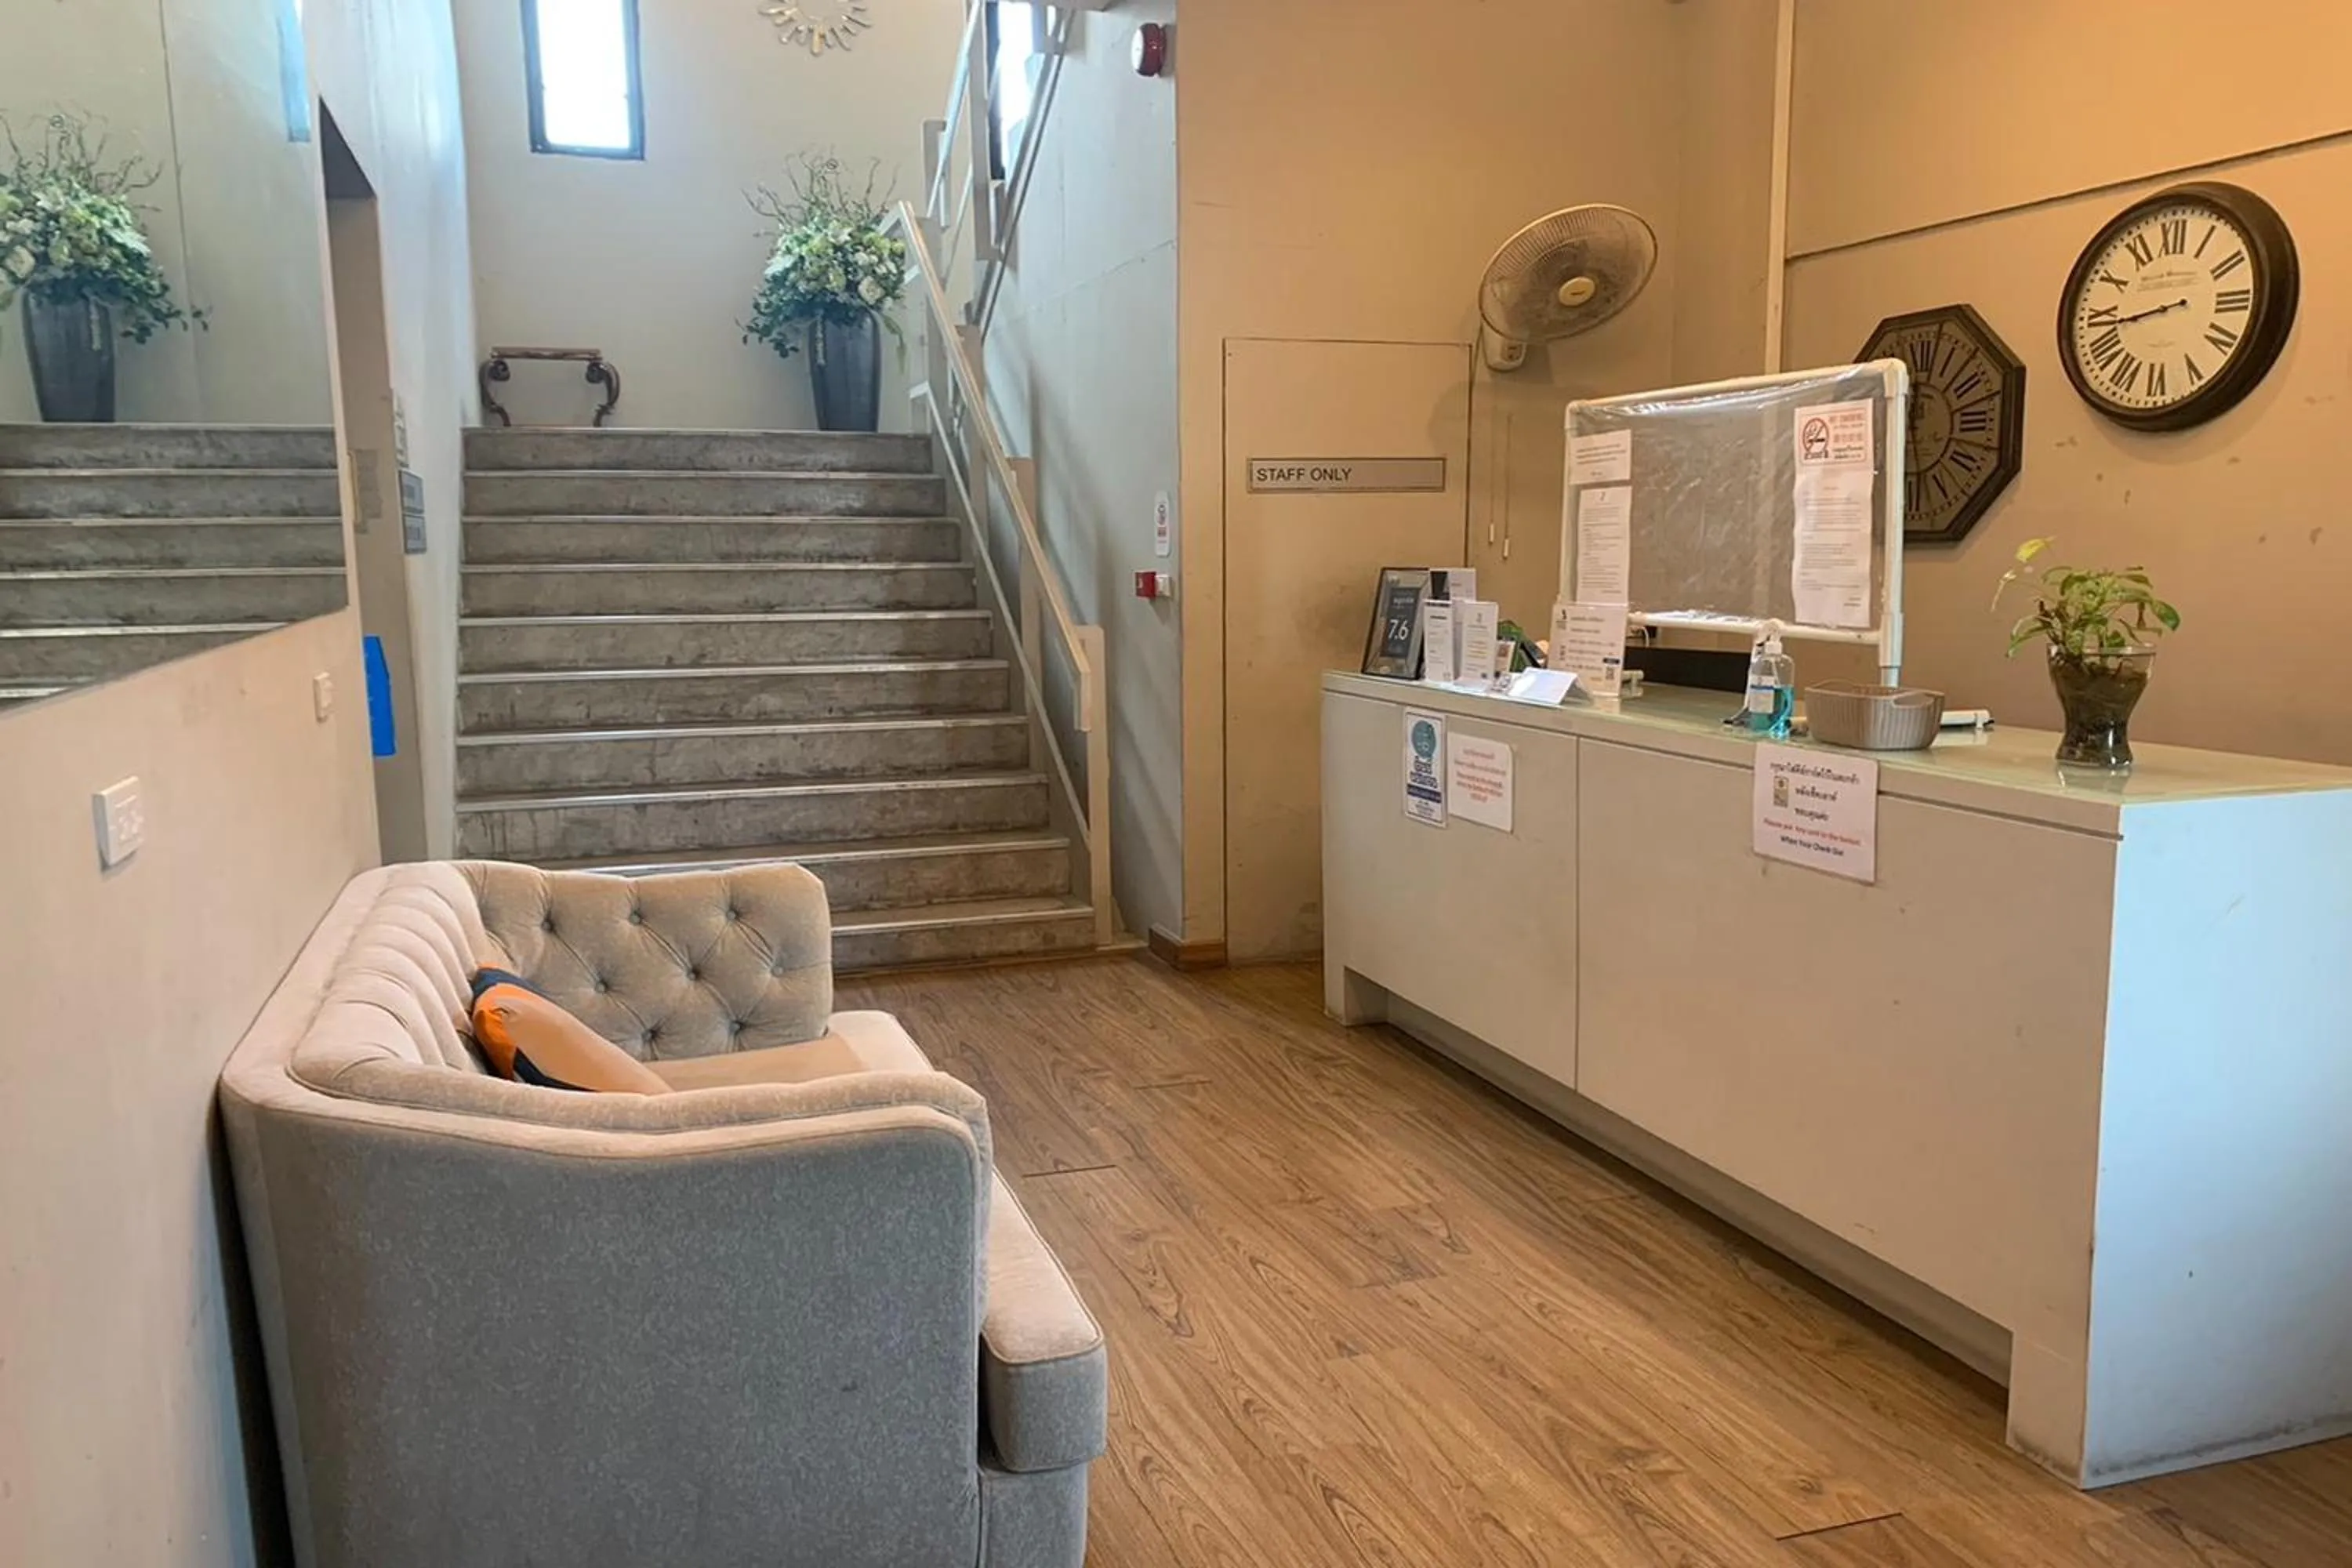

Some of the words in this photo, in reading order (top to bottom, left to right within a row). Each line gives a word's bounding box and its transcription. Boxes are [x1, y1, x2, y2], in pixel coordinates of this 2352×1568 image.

[2124, 232, 2154, 272] XI
[2158, 219, 2187, 258] XII
[2209, 249, 2246, 281] II
[2099, 269, 2130, 294] X
[2213, 289, 2251, 314] III
[2089, 325, 2126, 372] VIII
[2109, 351, 2143, 393] VII
[1256, 467, 1305, 482] STAFF
[1310, 466, 1352, 482] ONLY
[1388, 619, 1410, 641] 7.6
